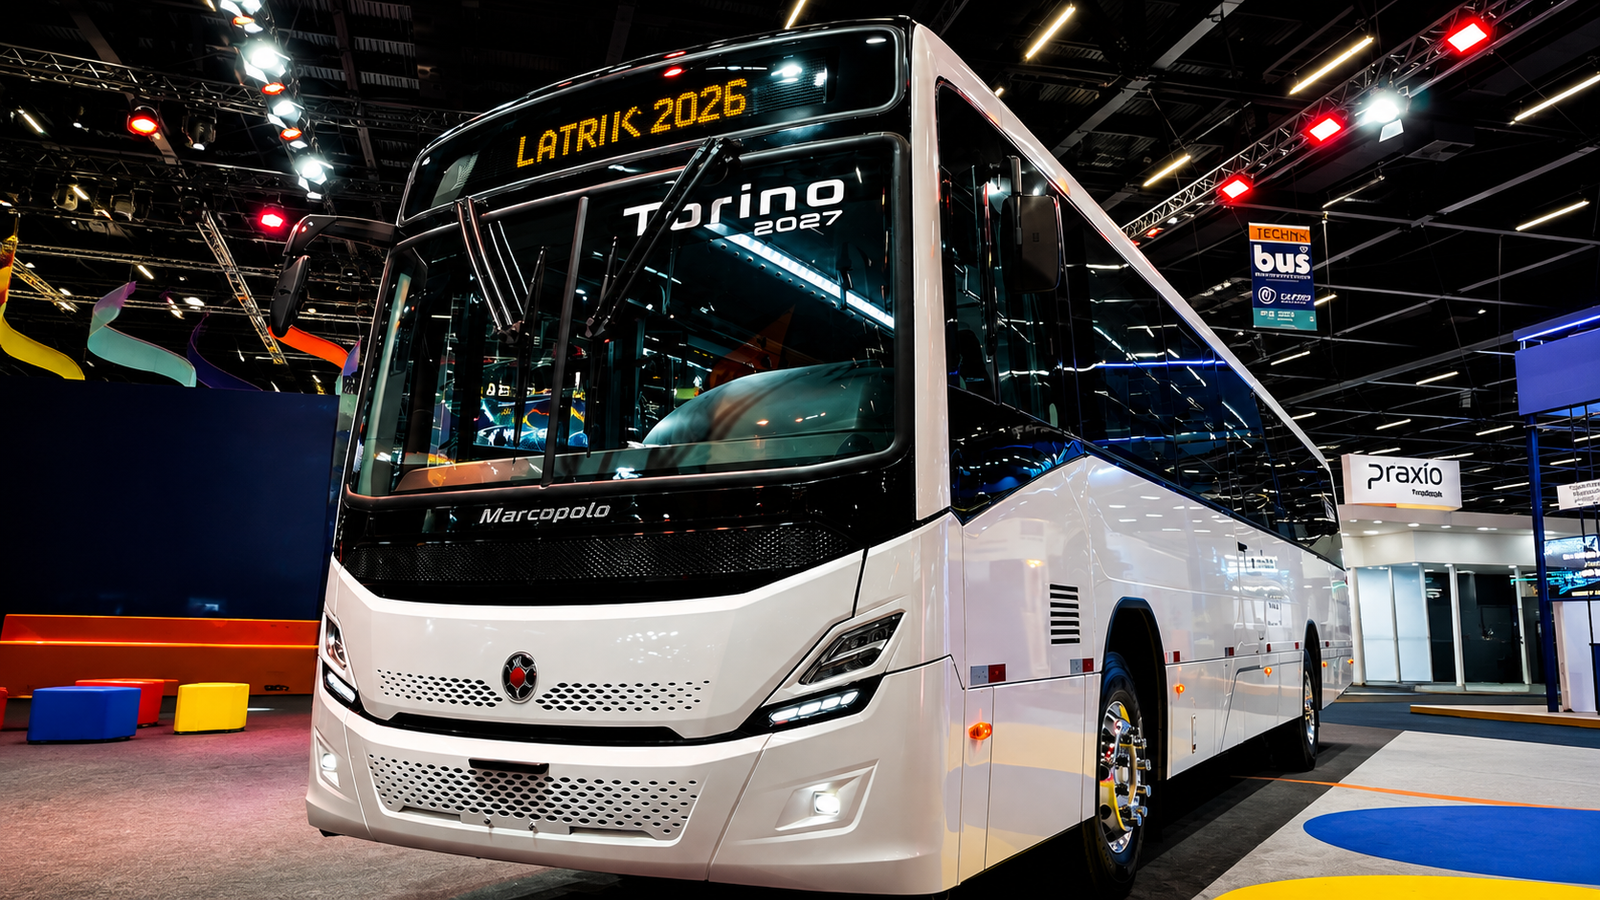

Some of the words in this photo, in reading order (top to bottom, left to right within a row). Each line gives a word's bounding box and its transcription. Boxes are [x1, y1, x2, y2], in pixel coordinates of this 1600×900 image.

[650, 78, 748, 134] 2026
[623, 178, 845, 236] Torino
[753, 209, 844, 236] 2027
[1253, 244, 1311, 275] bus
[479, 502, 611, 524] Marcopolo
